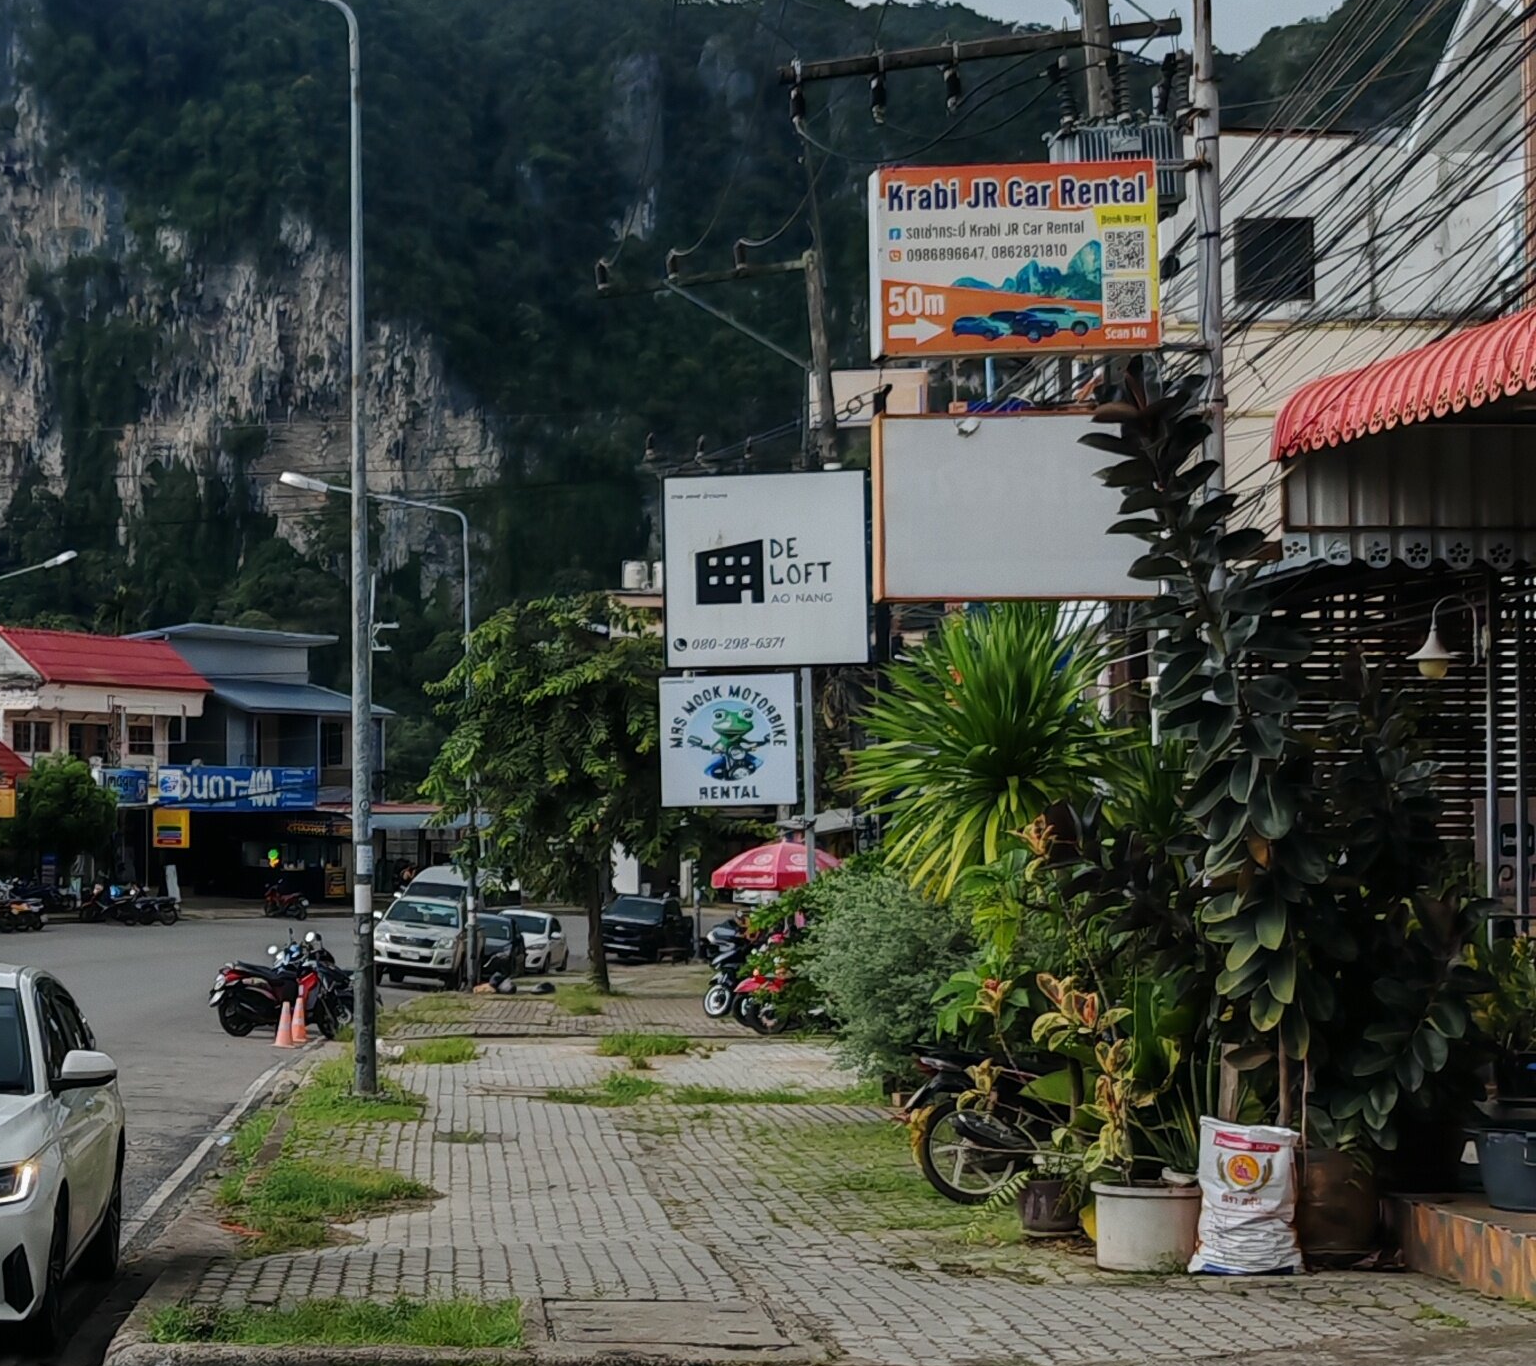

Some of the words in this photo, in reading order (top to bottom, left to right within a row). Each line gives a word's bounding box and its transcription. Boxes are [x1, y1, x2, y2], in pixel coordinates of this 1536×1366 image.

[887, 182, 957, 212] Krabi
[967, 181, 998, 209] JR
[1007, 180, 1052, 208] Car
[1060, 174, 1145, 206] Rental
[969, 223, 1001, 238] Krabi
[1005, 222, 1019, 236] JR
[1023, 222, 1043, 236] Car
[1046, 220, 1084, 235] Rental
[991, 243, 1068, 260] 0862821810
[888, 287, 945, 317] 50m
[1104, 328, 1129, 340] Scan
[770, 537, 798, 559] DE
[770, 561, 832, 585] LOFT
[771, 593, 791, 604] AO
[795, 592, 833, 604] NANG
[669, 716, 688, 748] MRS
[681, 685, 722, 715] MOOK
[728, 685, 787, 747] MOTORBIKE
[699, 785, 761, 800] RENTAL
